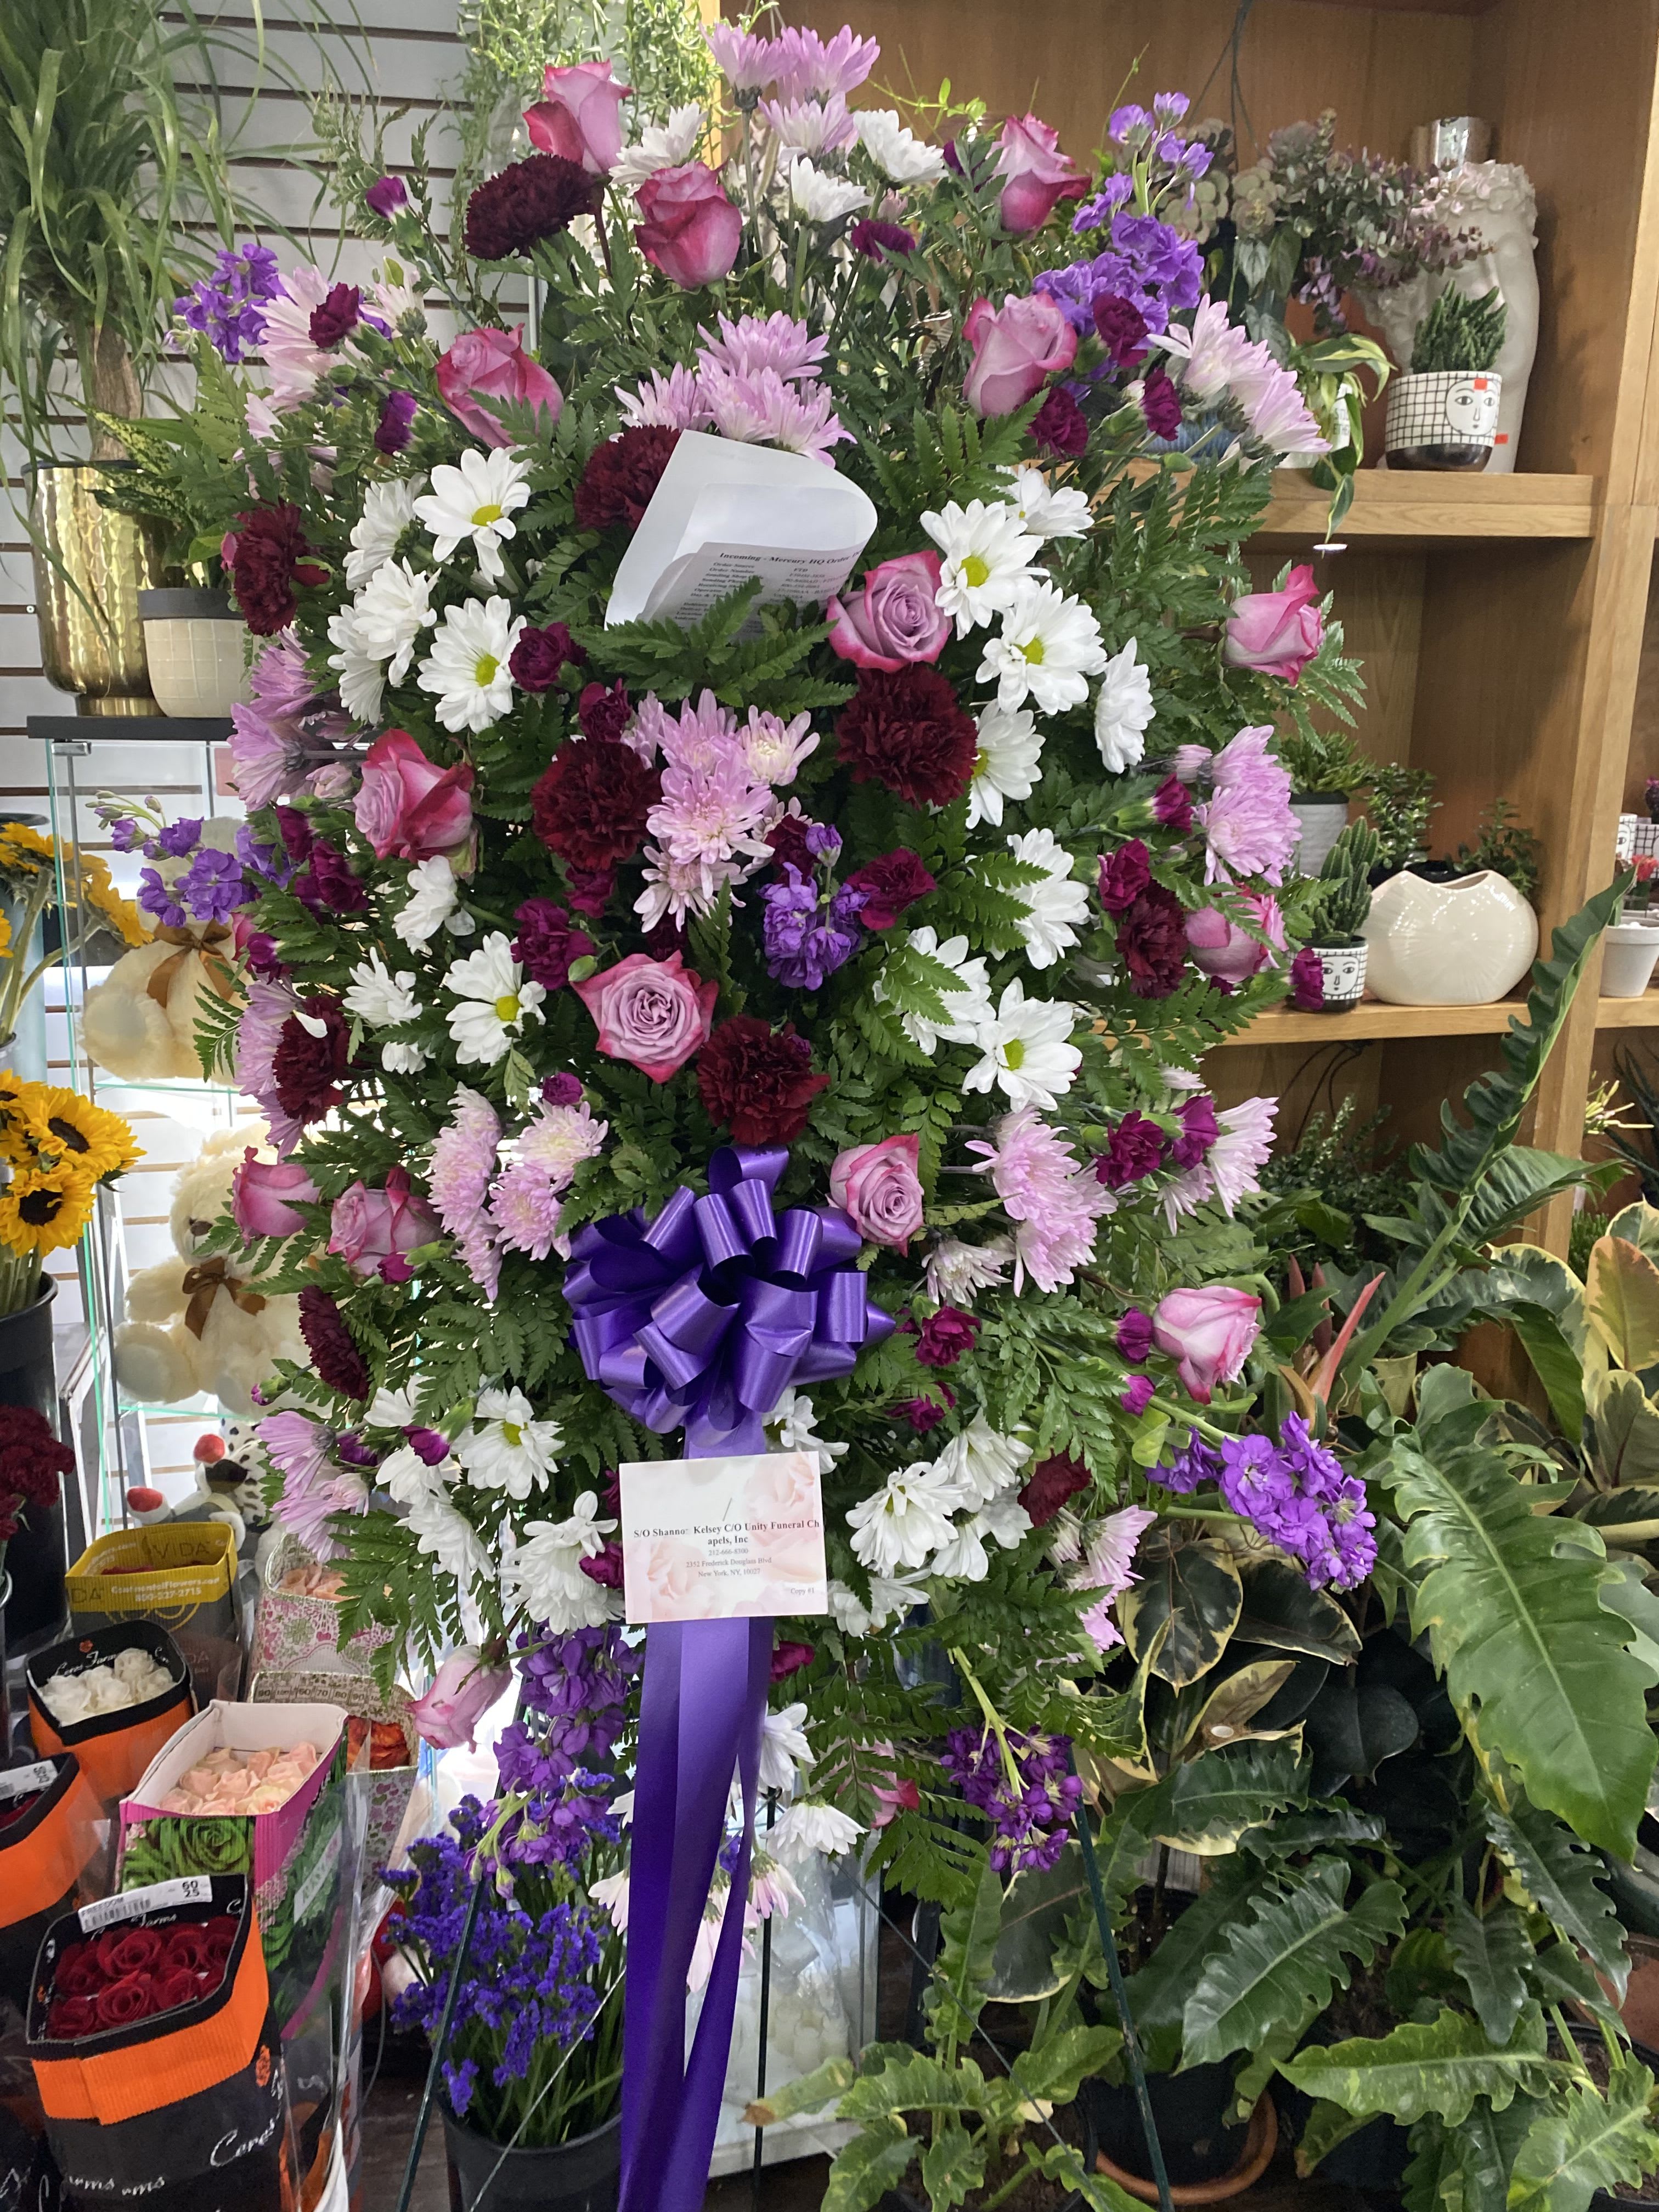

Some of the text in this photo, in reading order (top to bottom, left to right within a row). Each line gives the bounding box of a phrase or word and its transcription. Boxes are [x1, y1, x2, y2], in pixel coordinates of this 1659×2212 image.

[720, 552, 761, 561] Incoming
[769, 556, 805, 565] Mercury
[826, 556, 850, 564] Order
[634, 1529, 650, 1538] S/O
[693, 1525, 722, 1534] Kelsey
[725, 1523, 741, 1532] C/O
[745, 1522, 768, 1532] Unity
[771, 1521, 804, 1530] Funeral
[807, 1520, 820, 1528] Ch
[708, 1537, 732, 1547] apels,
[152, 1542, 210, 1559] VIDA
[731, 1558, 756, 1566] Douglass
[790, 1588, 806, 1596] Copy
